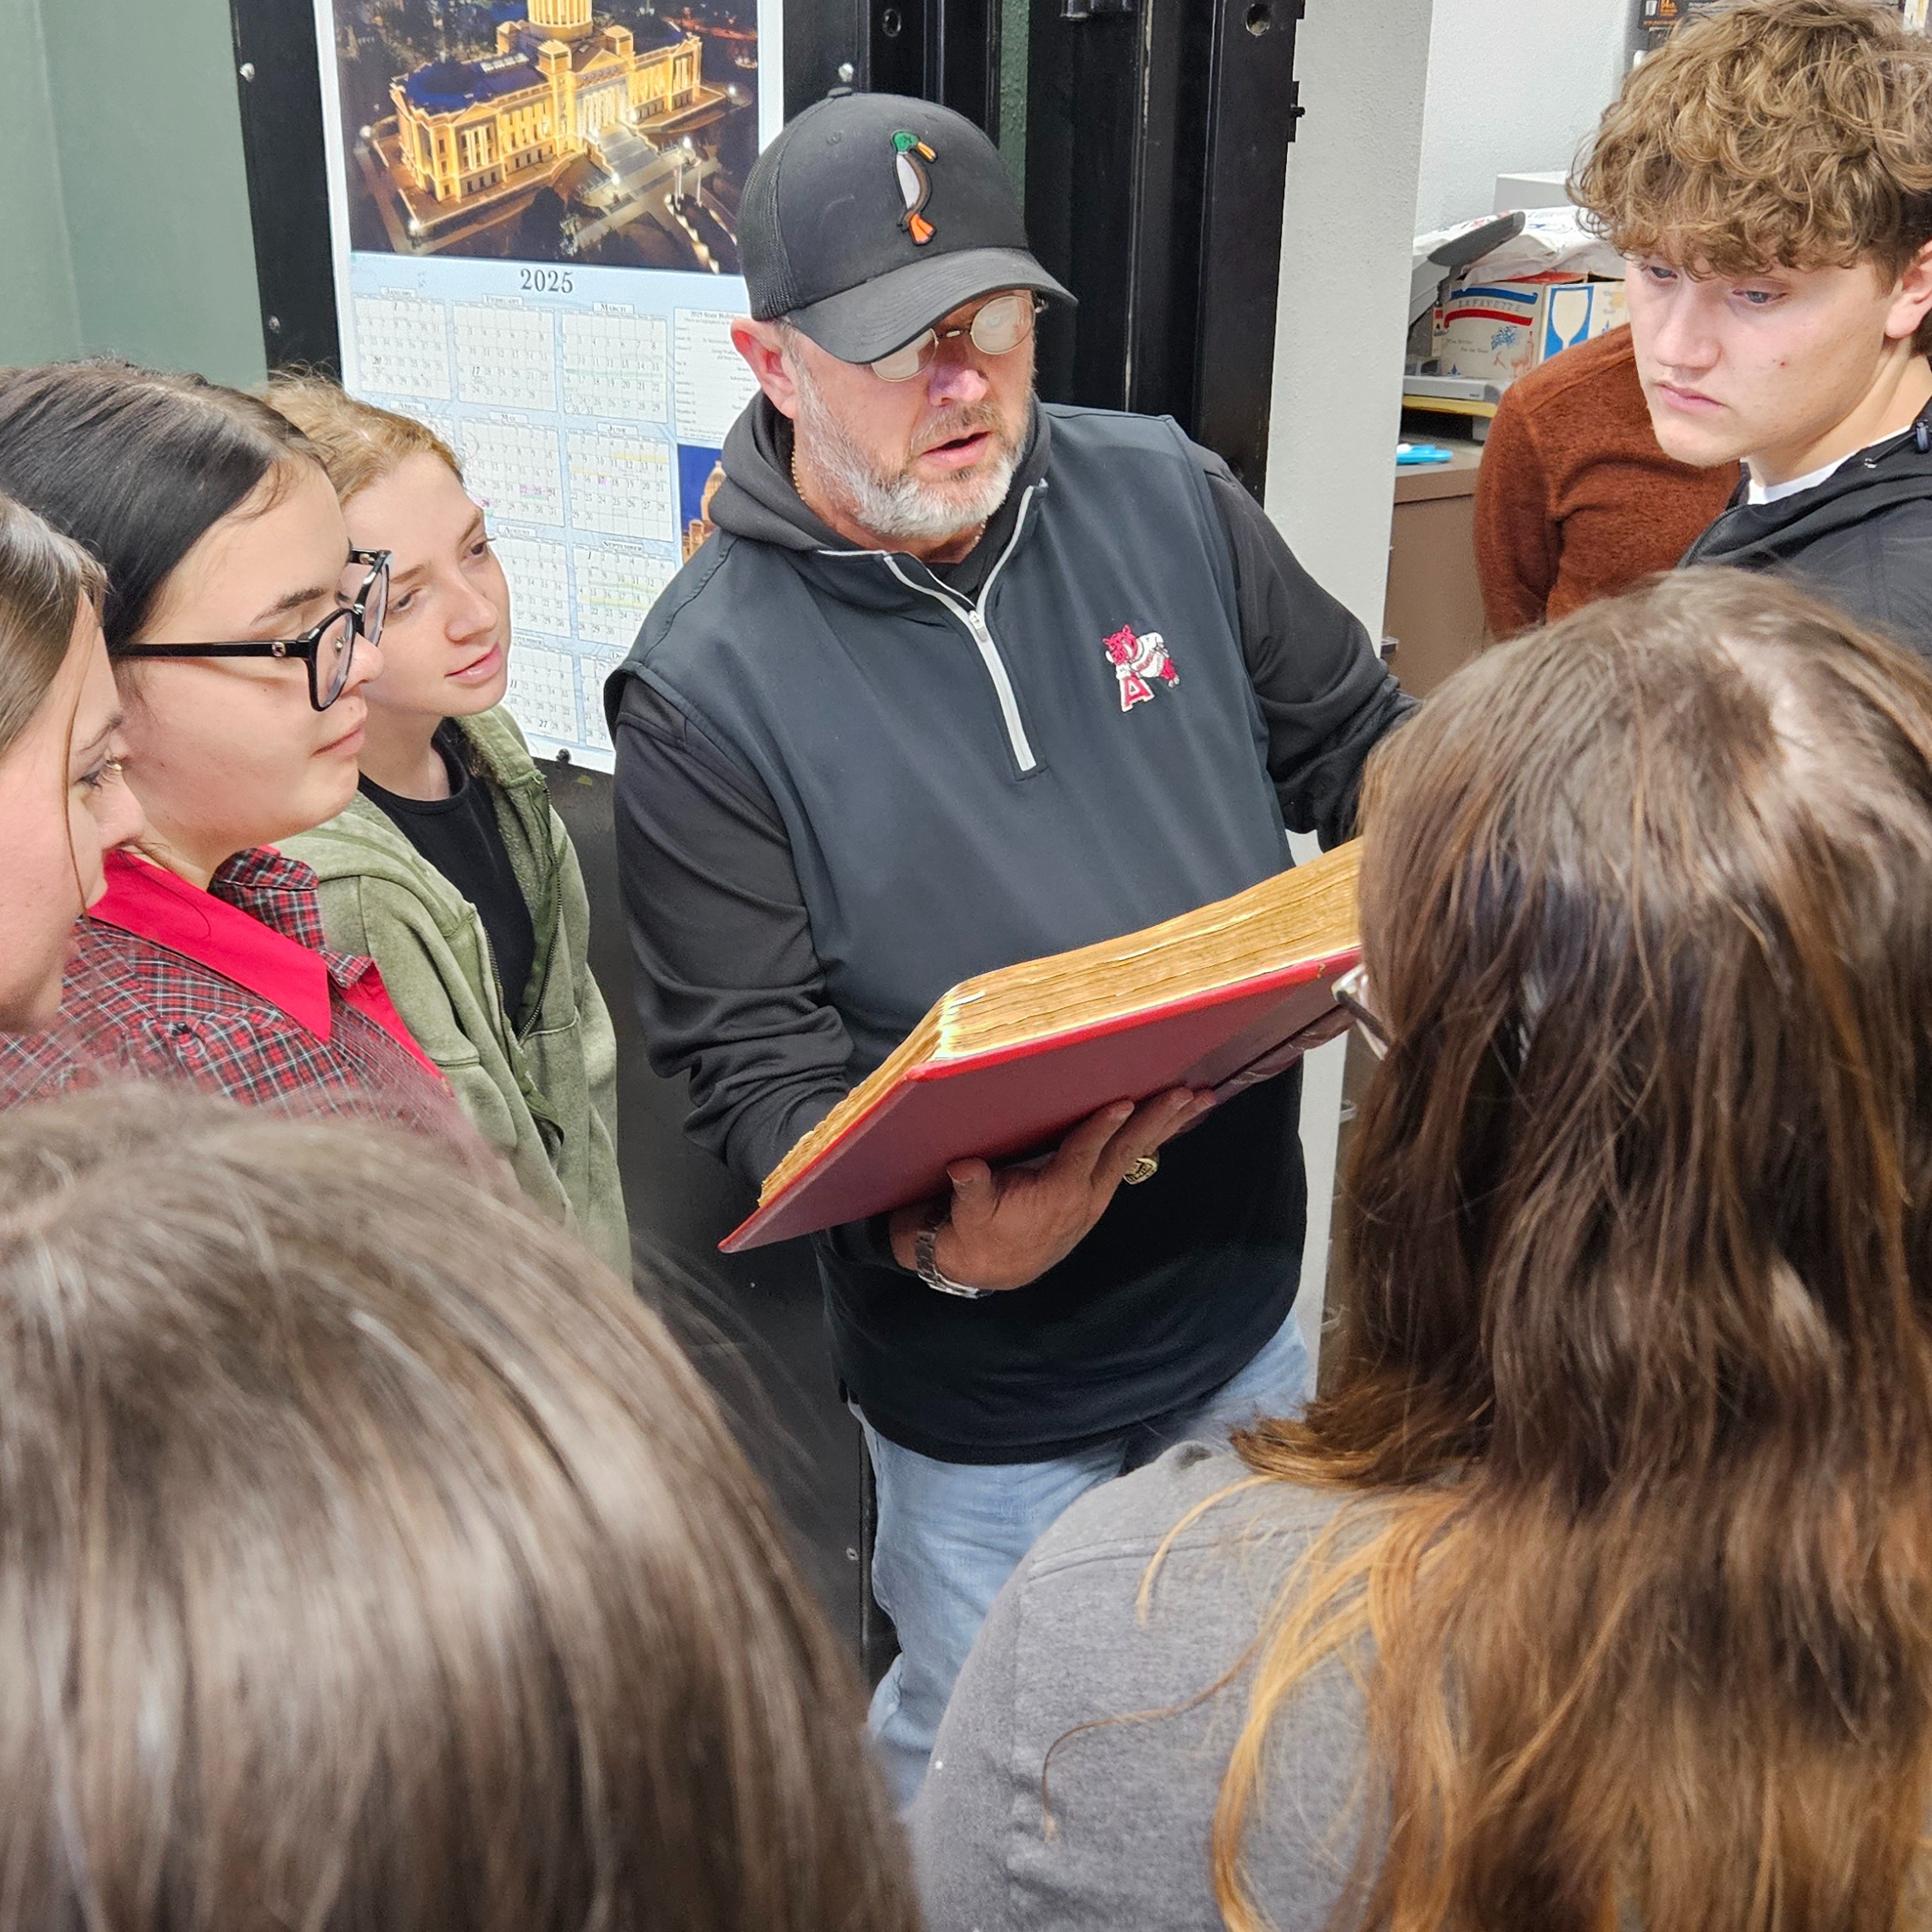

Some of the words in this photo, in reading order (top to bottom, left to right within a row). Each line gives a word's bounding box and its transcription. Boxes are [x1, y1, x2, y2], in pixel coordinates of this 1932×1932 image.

[520, 269, 574, 293] 2025
[1458, 299, 1522, 312] LAFAYETTE
[472, 366, 480, 376] 17
[638, 362, 645, 371] 14
[652, 363, 660, 372] 15
[594, 377, 601, 386] 18
[622, 381, 631, 389] 20
[637, 382, 645, 391] 21
[652, 383, 660, 393] 22
[638, 402, 646, 411] 28
[652, 403, 661, 413] 29
[625, 461, 633, 470] 12
[642, 462, 649, 471] 13
[655, 463, 663, 473] 14
[626, 479, 634, 488] 19
[642, 482, 650, 491] 20
[655, 483, 664, 492] 21
[599, 495, 607, 504] 24
[613, 498, 620, 506] 25
[627, 499, 636, 508] 26
[643, 501, 651, 510] 27
[657, 503, 666, 512] 28
[603, 540, 643, 551] SEPTEMBER
[589, 551, 592, 560] 1
[528, 577, 535, 586] 14
[541, 580, 549, 589] 15
[618, 573, 625, 583] 10
[633, 576, 639, 585] 11
[648, 577, 655, 588] 12
[605, 590, 612, 600] 16
[633, 594, 642, 604] 18
[556, 601, 564, 609] 23
[590, 606, 599, 615] 22
[605, 608, 613, 618] 23
[619, 610, 628, 619] 24
[635, 613, 643, 622] 25
[578, 623, 586, 631] 28
[592, 625, 601, 633] 29
[607, 626, 615, 636] 30
[510, 679, 517, 689] 11
[1119, 675, 1155, 712] A
[539, 720, 548, 728] 27
